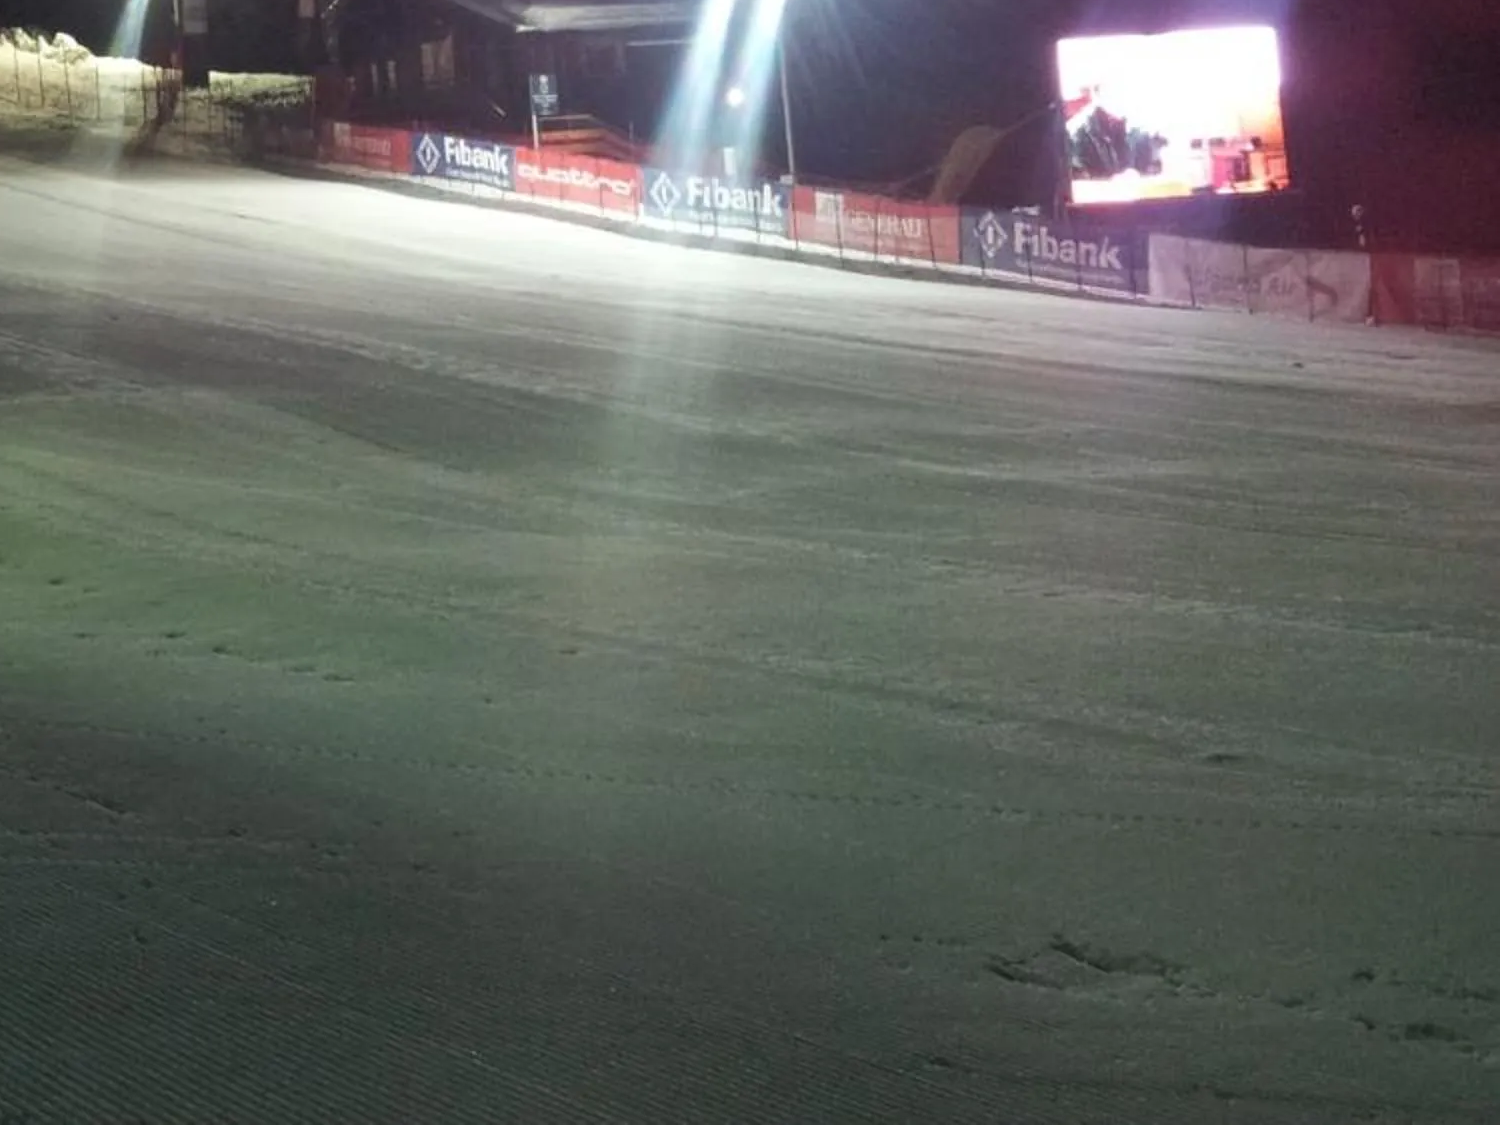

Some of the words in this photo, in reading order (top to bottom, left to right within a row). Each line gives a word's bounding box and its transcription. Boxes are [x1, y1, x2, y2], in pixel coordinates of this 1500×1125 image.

[443, 135, 509, 175] Fibank
[686, 176, 783, 217] Fibank
[1012, 221, 1124, 270] Fibank
